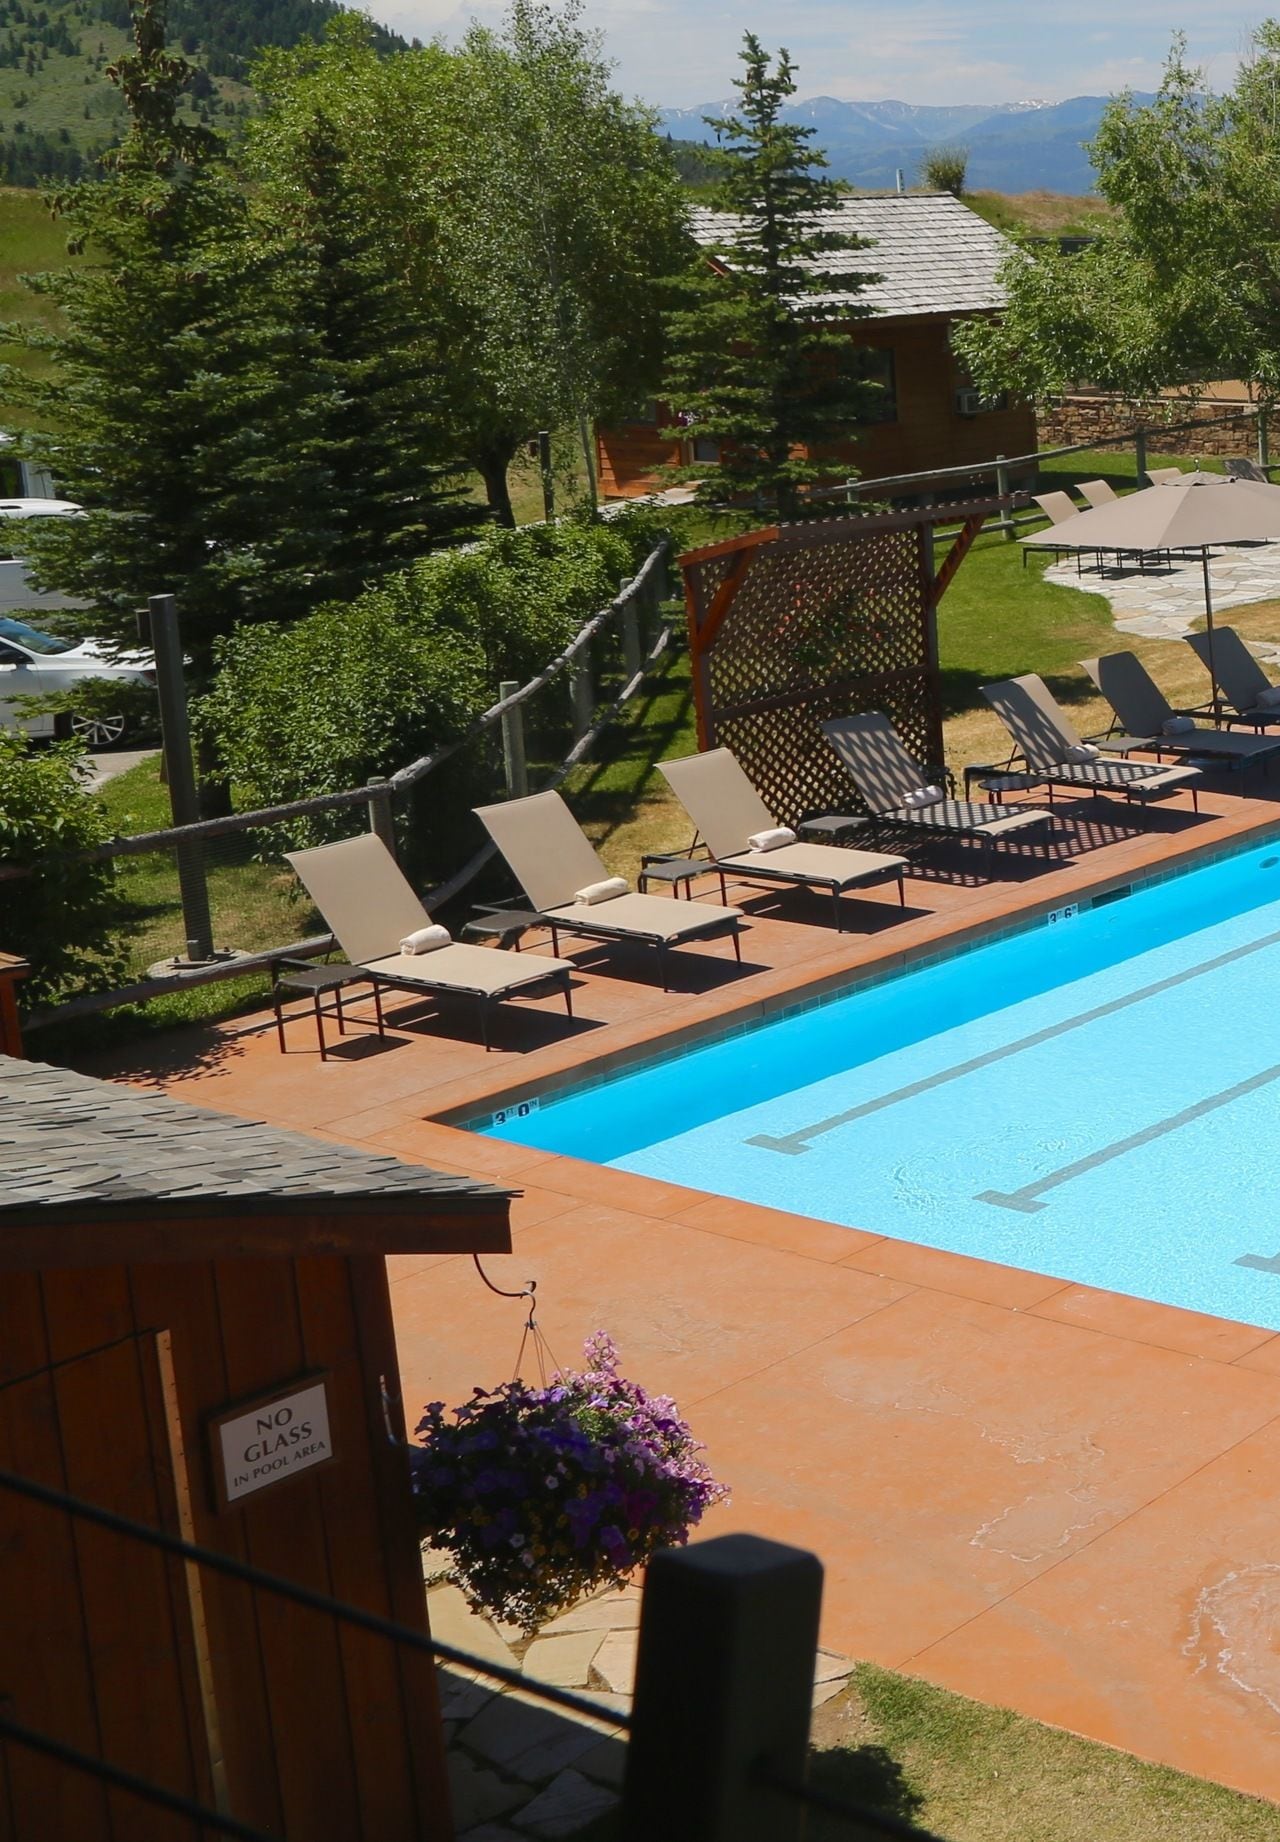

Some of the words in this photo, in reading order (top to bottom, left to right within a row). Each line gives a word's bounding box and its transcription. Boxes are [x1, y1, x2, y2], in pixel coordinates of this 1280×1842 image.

[1064, 907, 1072, 918] 6
[495, 1111, 506, 1126] 3
[518, 1103, 530, 1117] 0
[257, 1407, 293, 1435] NO
[243, 1421, 313, 1463] GLASS
[233, 1473, 249, 1487] IN
[253, 1456, 290, 1478] POOL
[293, 1440, 326, 1460] AREA
